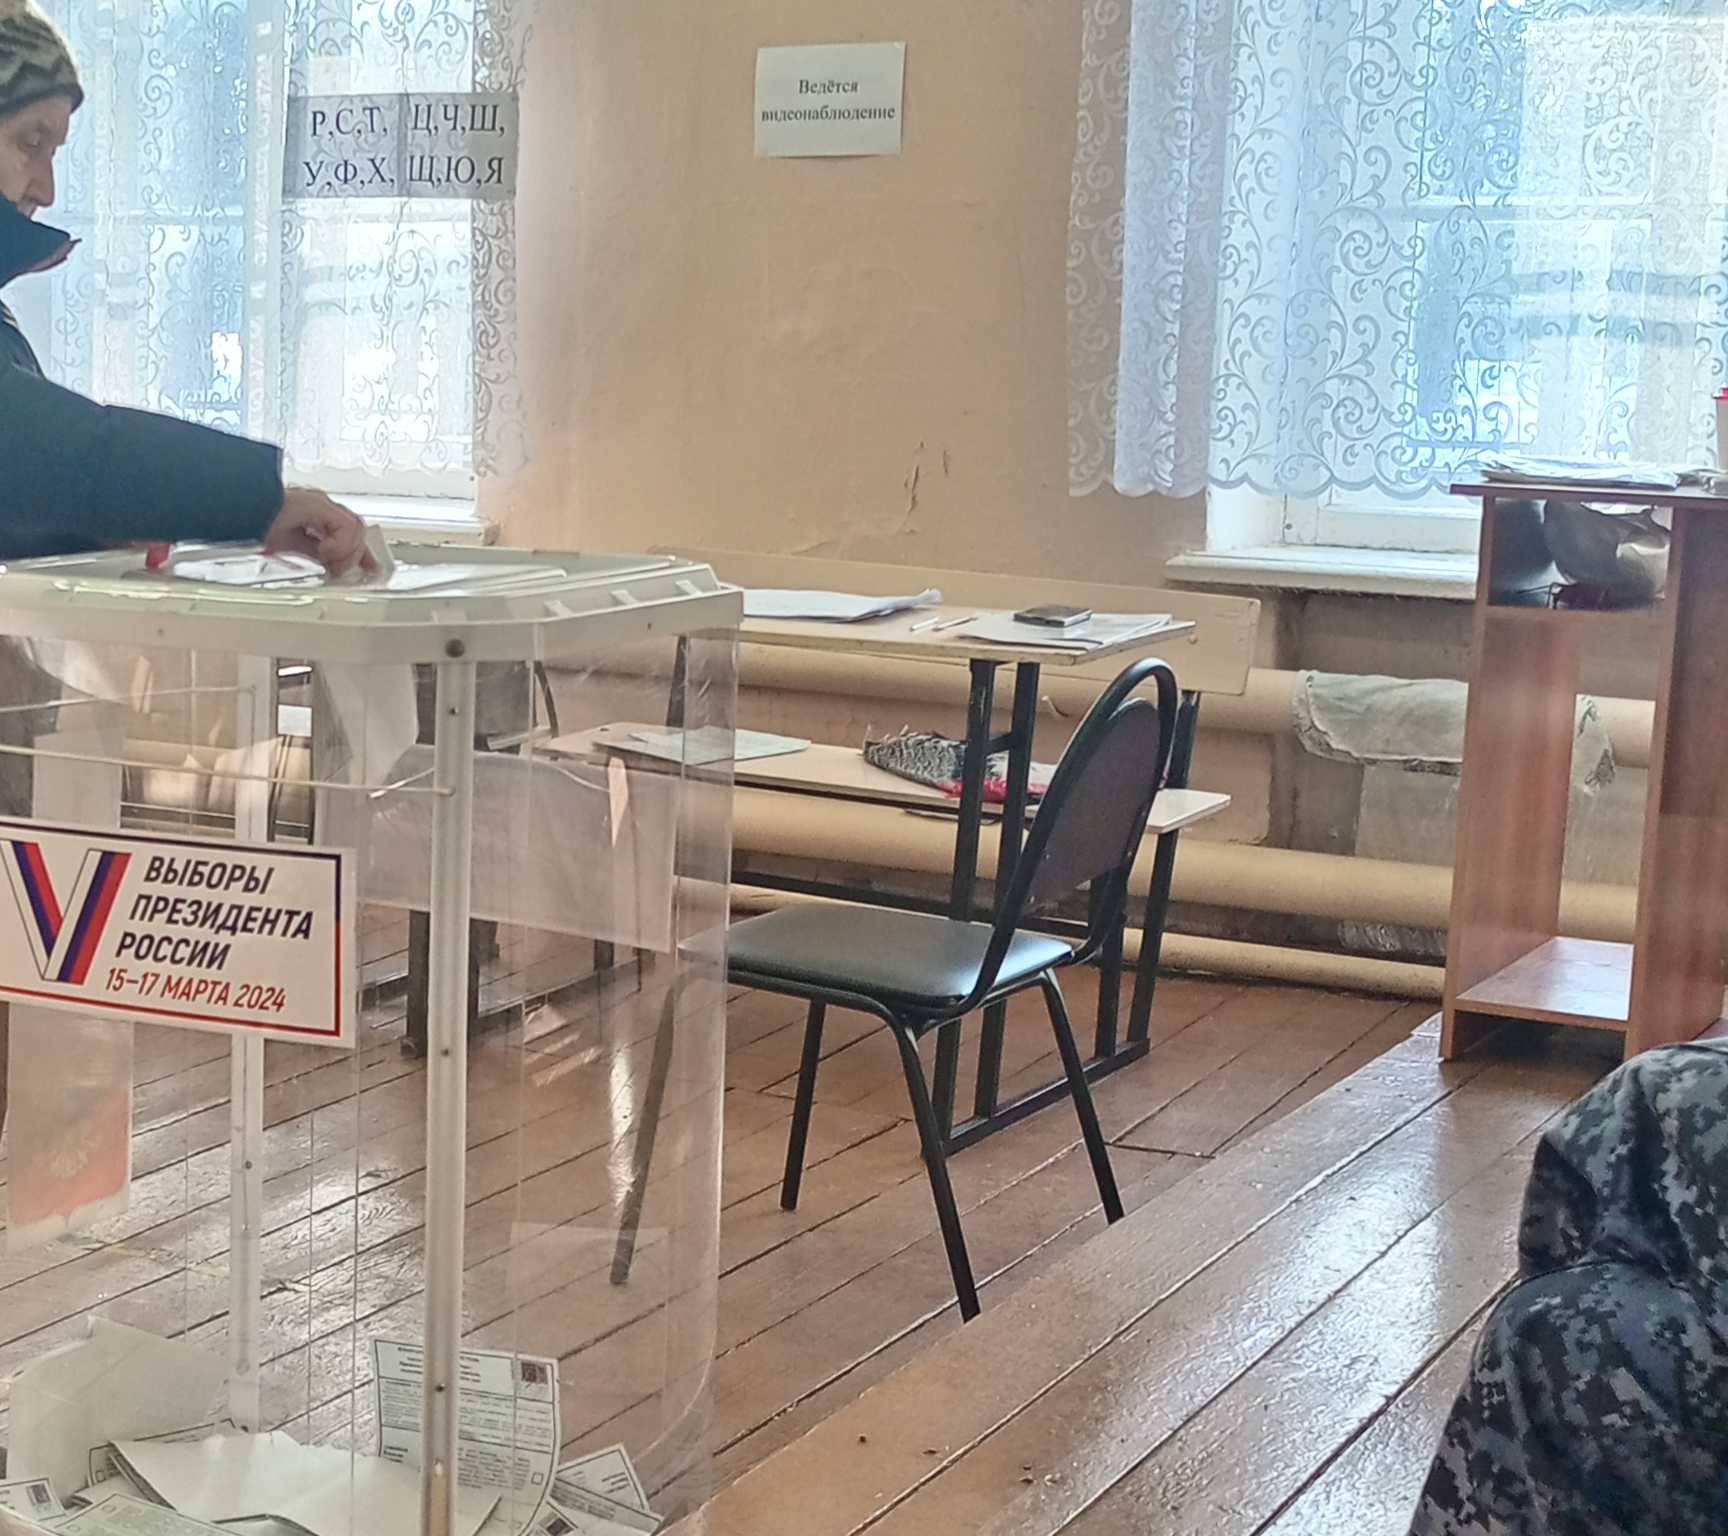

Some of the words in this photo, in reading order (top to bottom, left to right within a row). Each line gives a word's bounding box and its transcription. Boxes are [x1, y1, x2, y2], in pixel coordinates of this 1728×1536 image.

[799, 78, 859, 95] Ведётся
[761, 104, 896, 122] видеонаблюдение
[142, 855, 275, 895] ВЫБОРЫ
[128, 893, 314, 941] ПРЕЗИДЕНТА
[114, 931, 232, 971] РОССИИ
[161, 977, 232, 1007] МАРТА
[233, 984, 286, 1013] 2024
